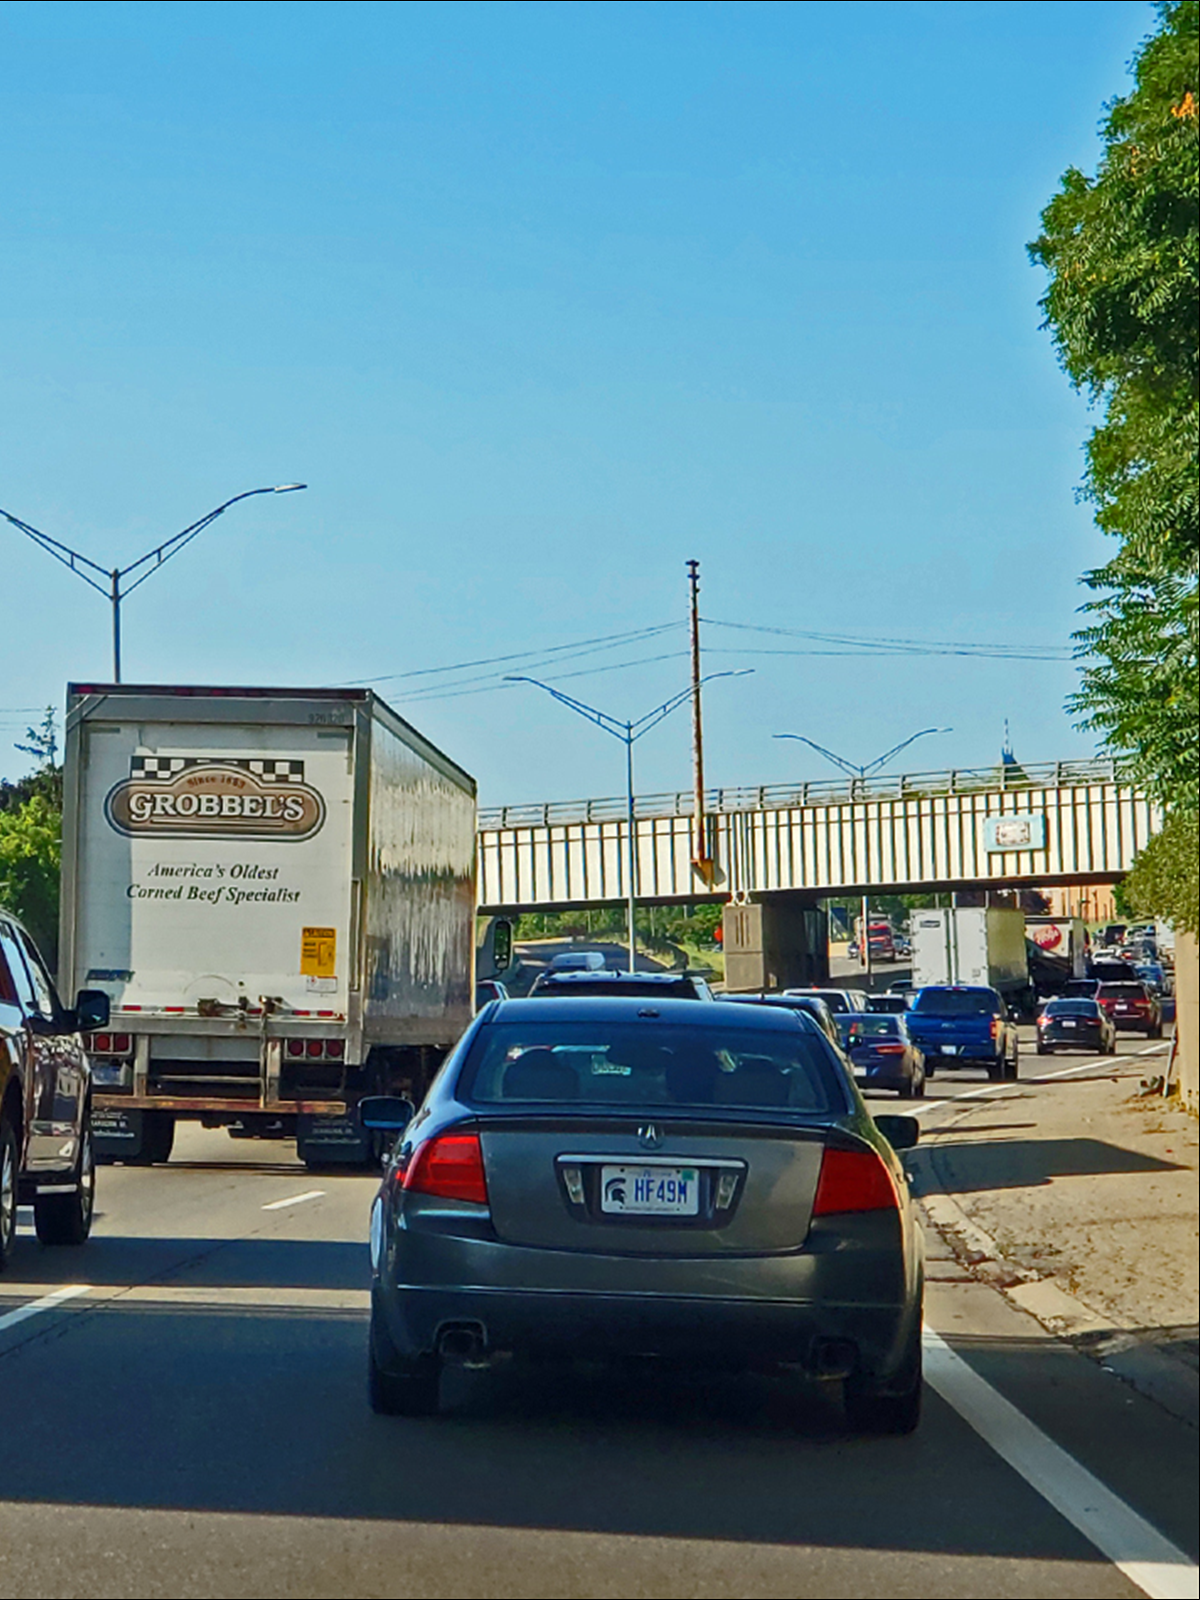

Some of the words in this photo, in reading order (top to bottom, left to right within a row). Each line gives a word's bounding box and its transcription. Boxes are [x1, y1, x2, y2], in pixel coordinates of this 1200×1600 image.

[187, 776, 217, 789] Since
[129, 793, 304, 822] GROBBEL'S
[147, 863, 225, 878] America's
[230, 863, 279, 880] Oldest
[126, 883, 184, 900] Corned
[187, 886, 227, 905] Beef
[225, 886, 301, 905] Specialist
